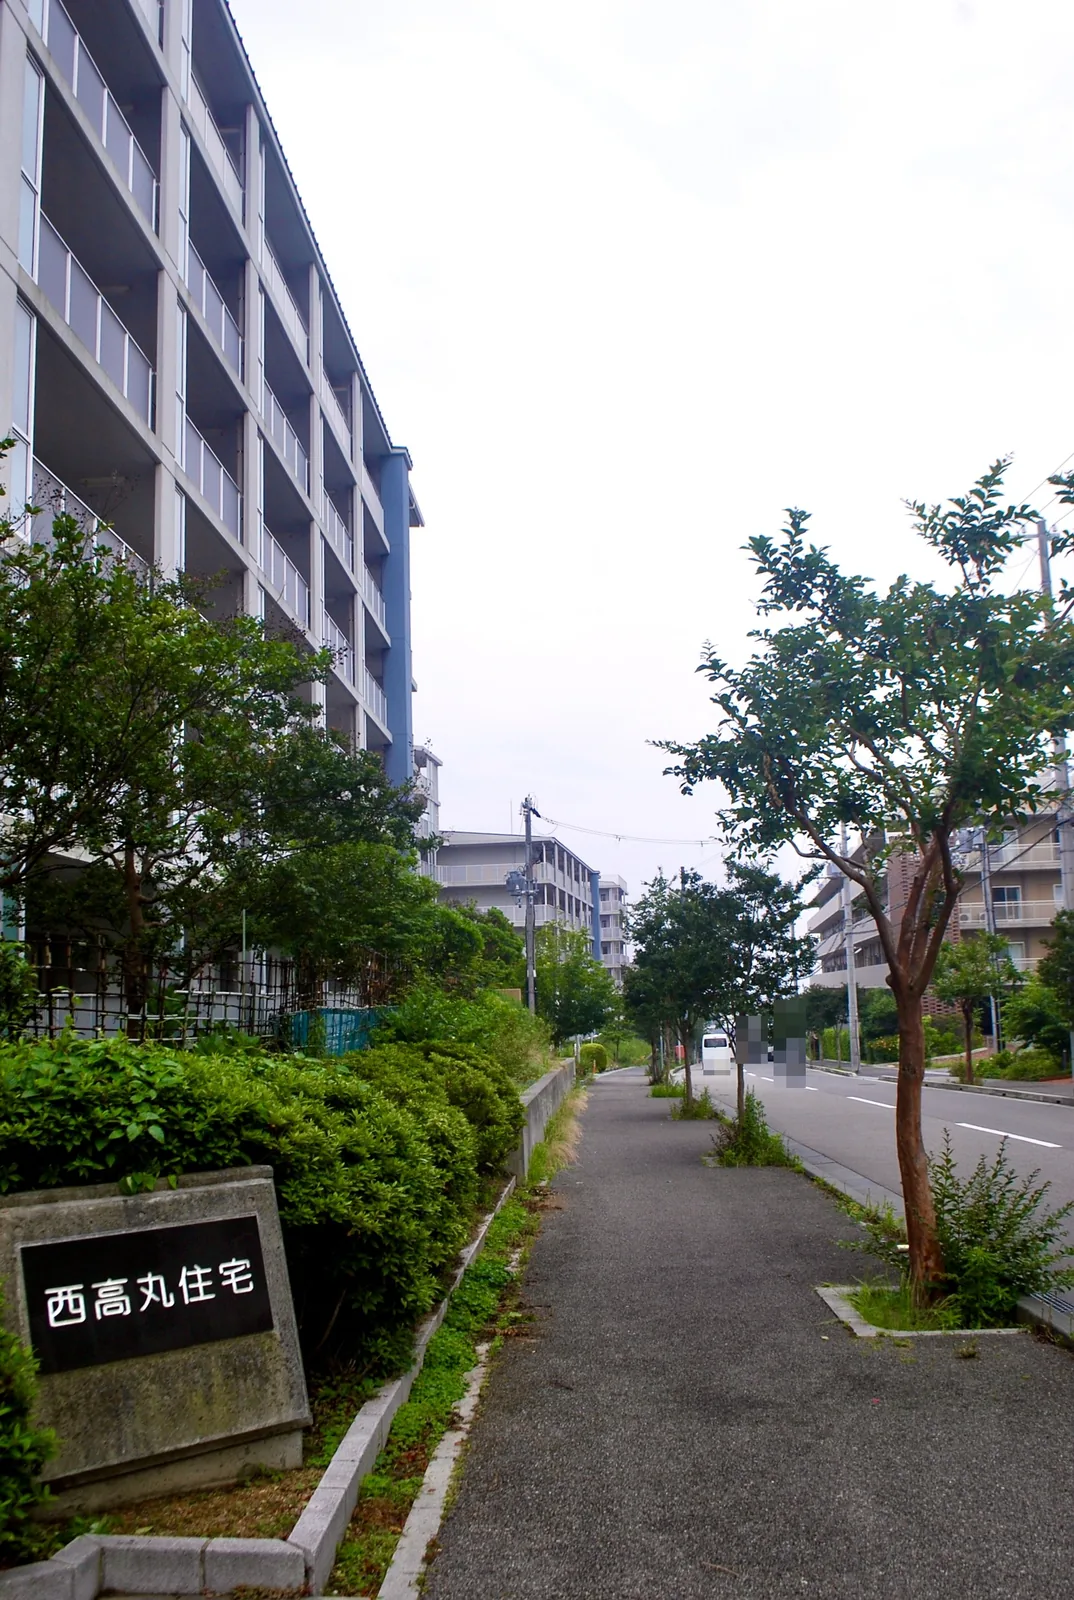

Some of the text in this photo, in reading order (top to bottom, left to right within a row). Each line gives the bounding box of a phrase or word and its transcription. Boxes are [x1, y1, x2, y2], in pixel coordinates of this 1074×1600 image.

[44, 1257, 254, 1328] 西高丸住宅
